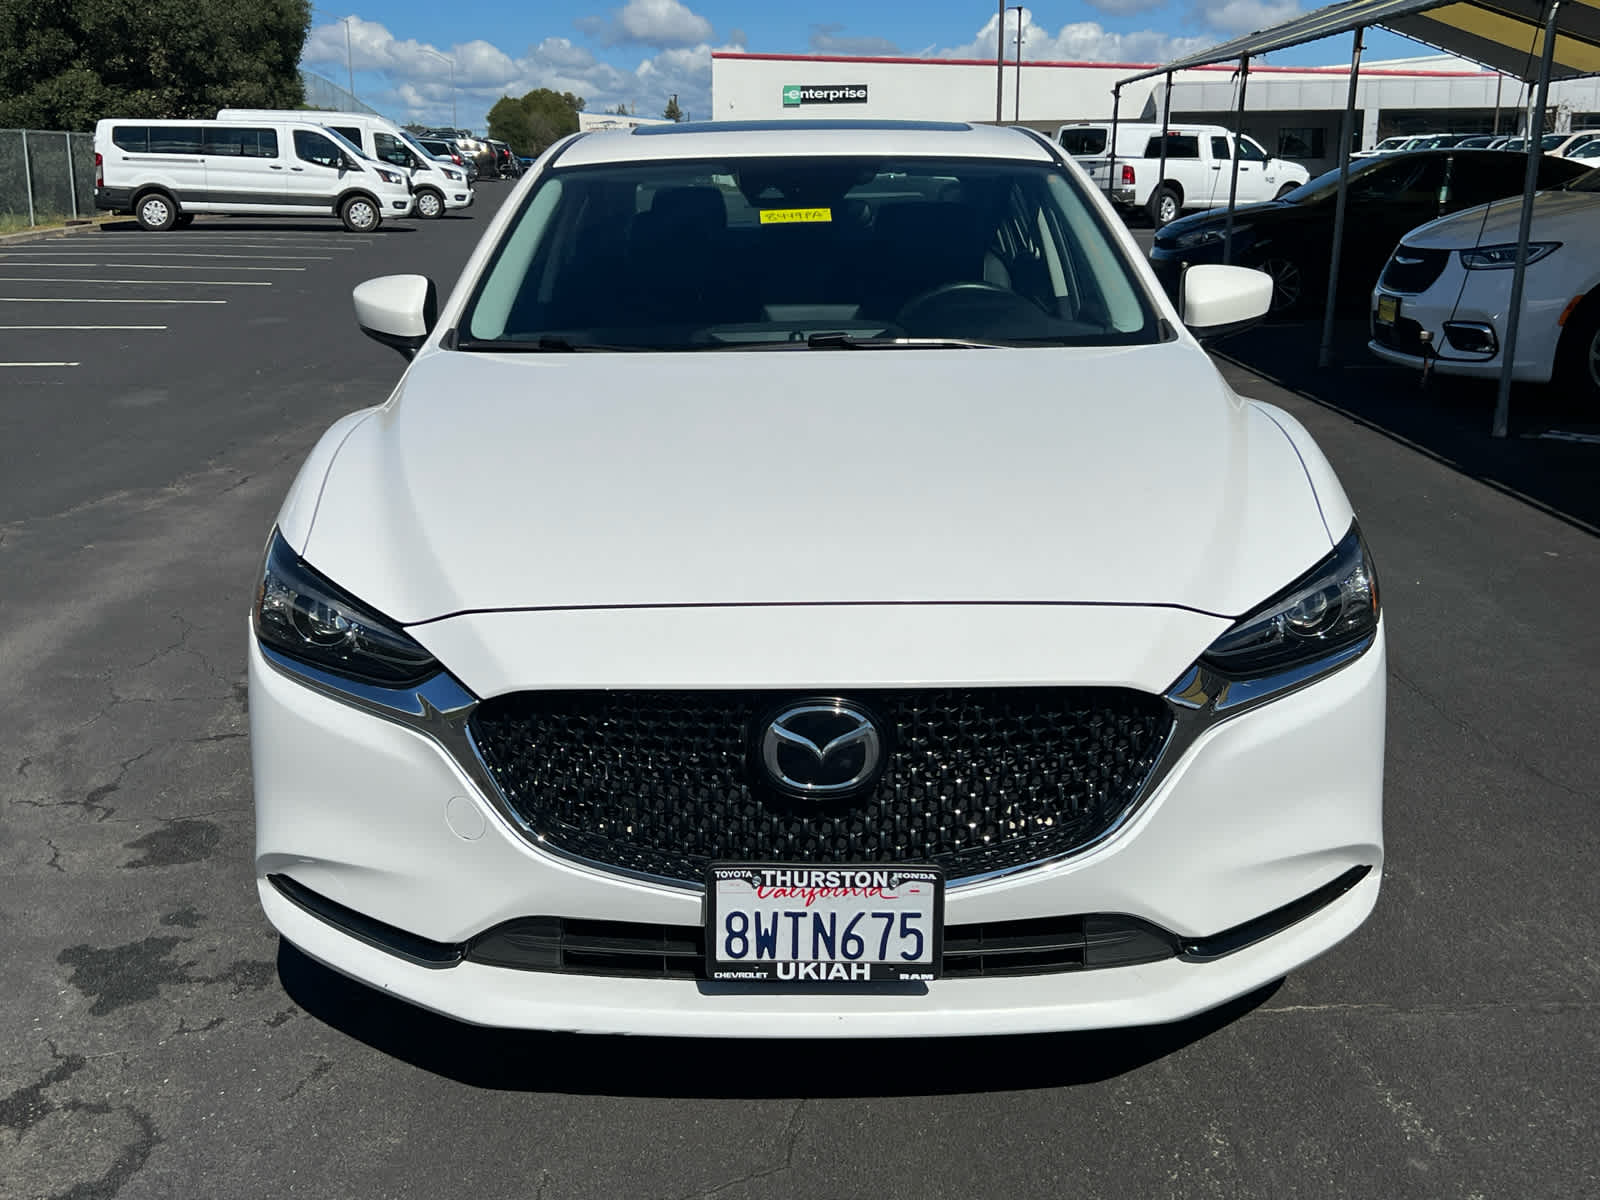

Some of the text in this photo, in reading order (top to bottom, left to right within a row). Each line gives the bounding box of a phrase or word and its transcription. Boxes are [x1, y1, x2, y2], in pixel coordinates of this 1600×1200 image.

[789, 87, 866, 101] enterprise
[715, 870, 752, 878] TOYOTA
[761, 870, 888, 887] THURSTON
[893, 872, 937, 880] HONDA
[725, 911, 924, 960] 8WTN675
[776, 962, 870, 980] UKIAH
